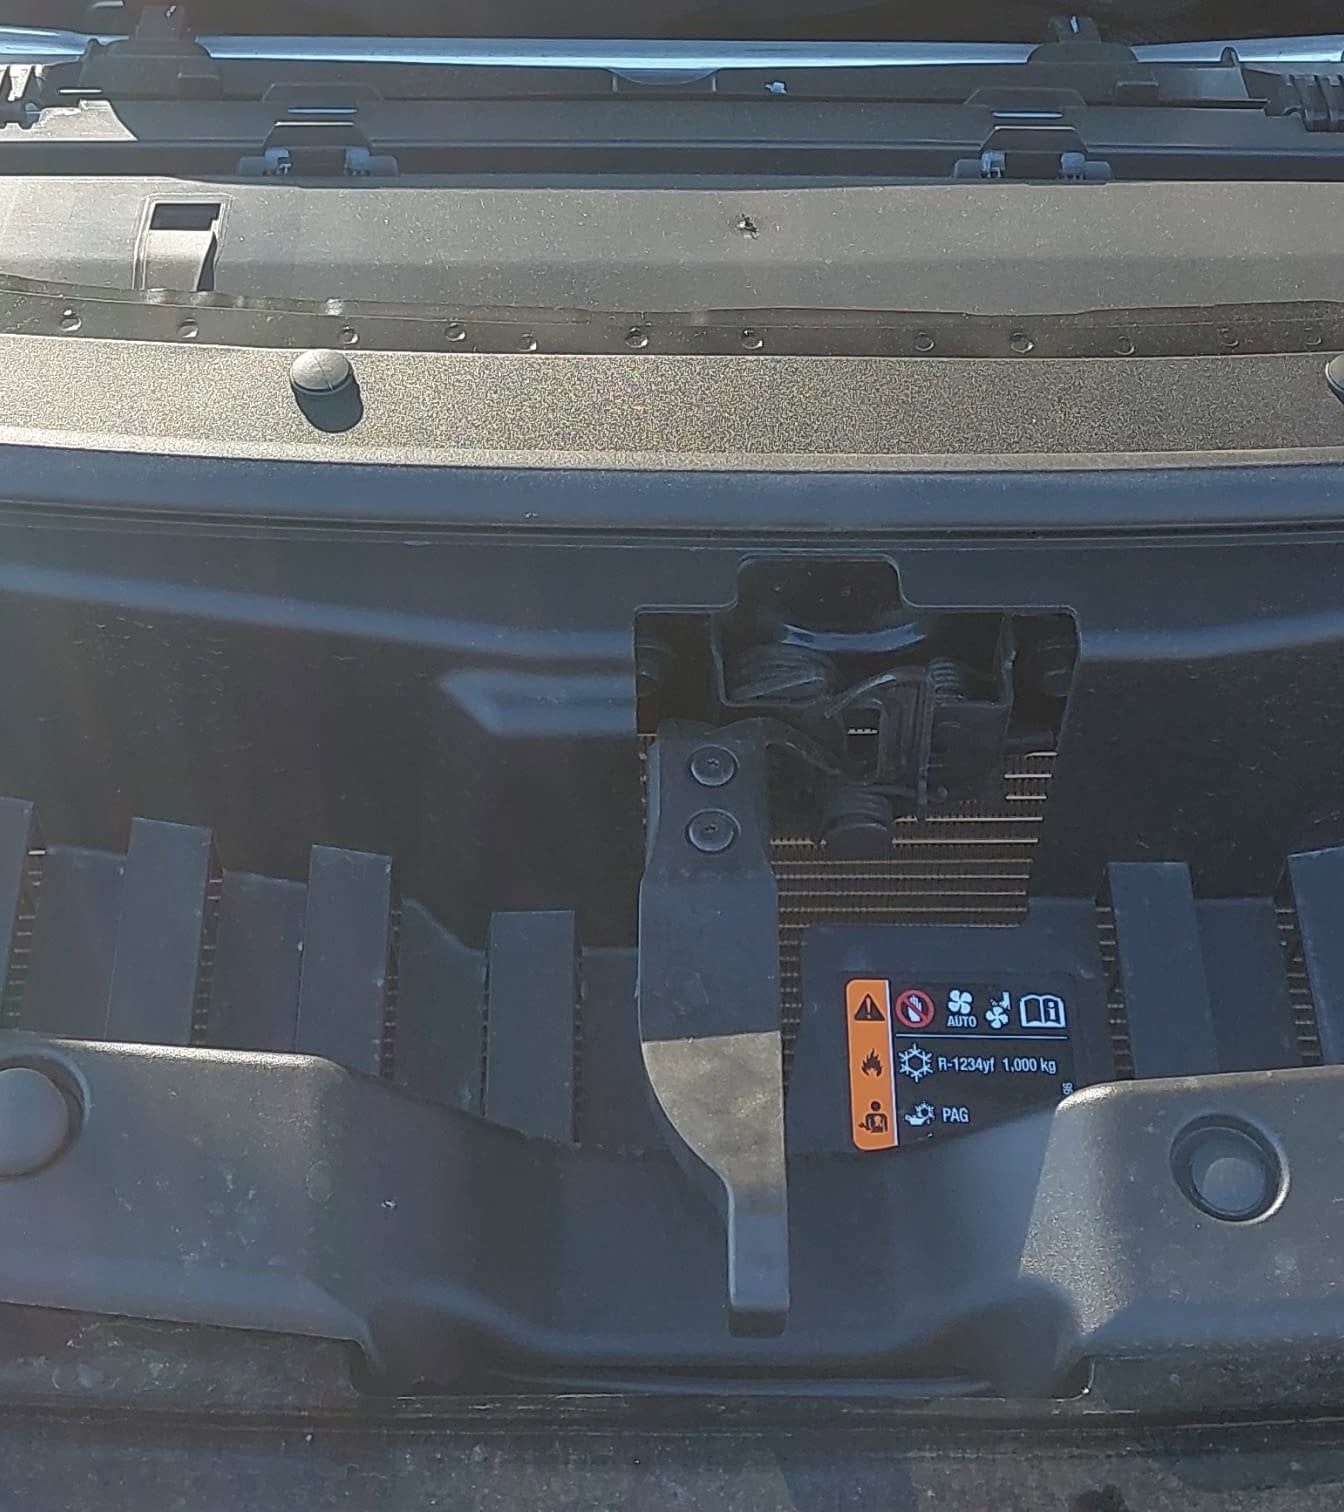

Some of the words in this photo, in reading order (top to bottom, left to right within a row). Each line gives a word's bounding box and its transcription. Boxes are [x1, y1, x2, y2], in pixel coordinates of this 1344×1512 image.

[947, 1015, 977, 1028] AUTO
[937, 1056, 995, 1074] R-1234yf
[1039, 1056, 1056, 1075] kg
[942, 1107, 969, 1123] PAG
